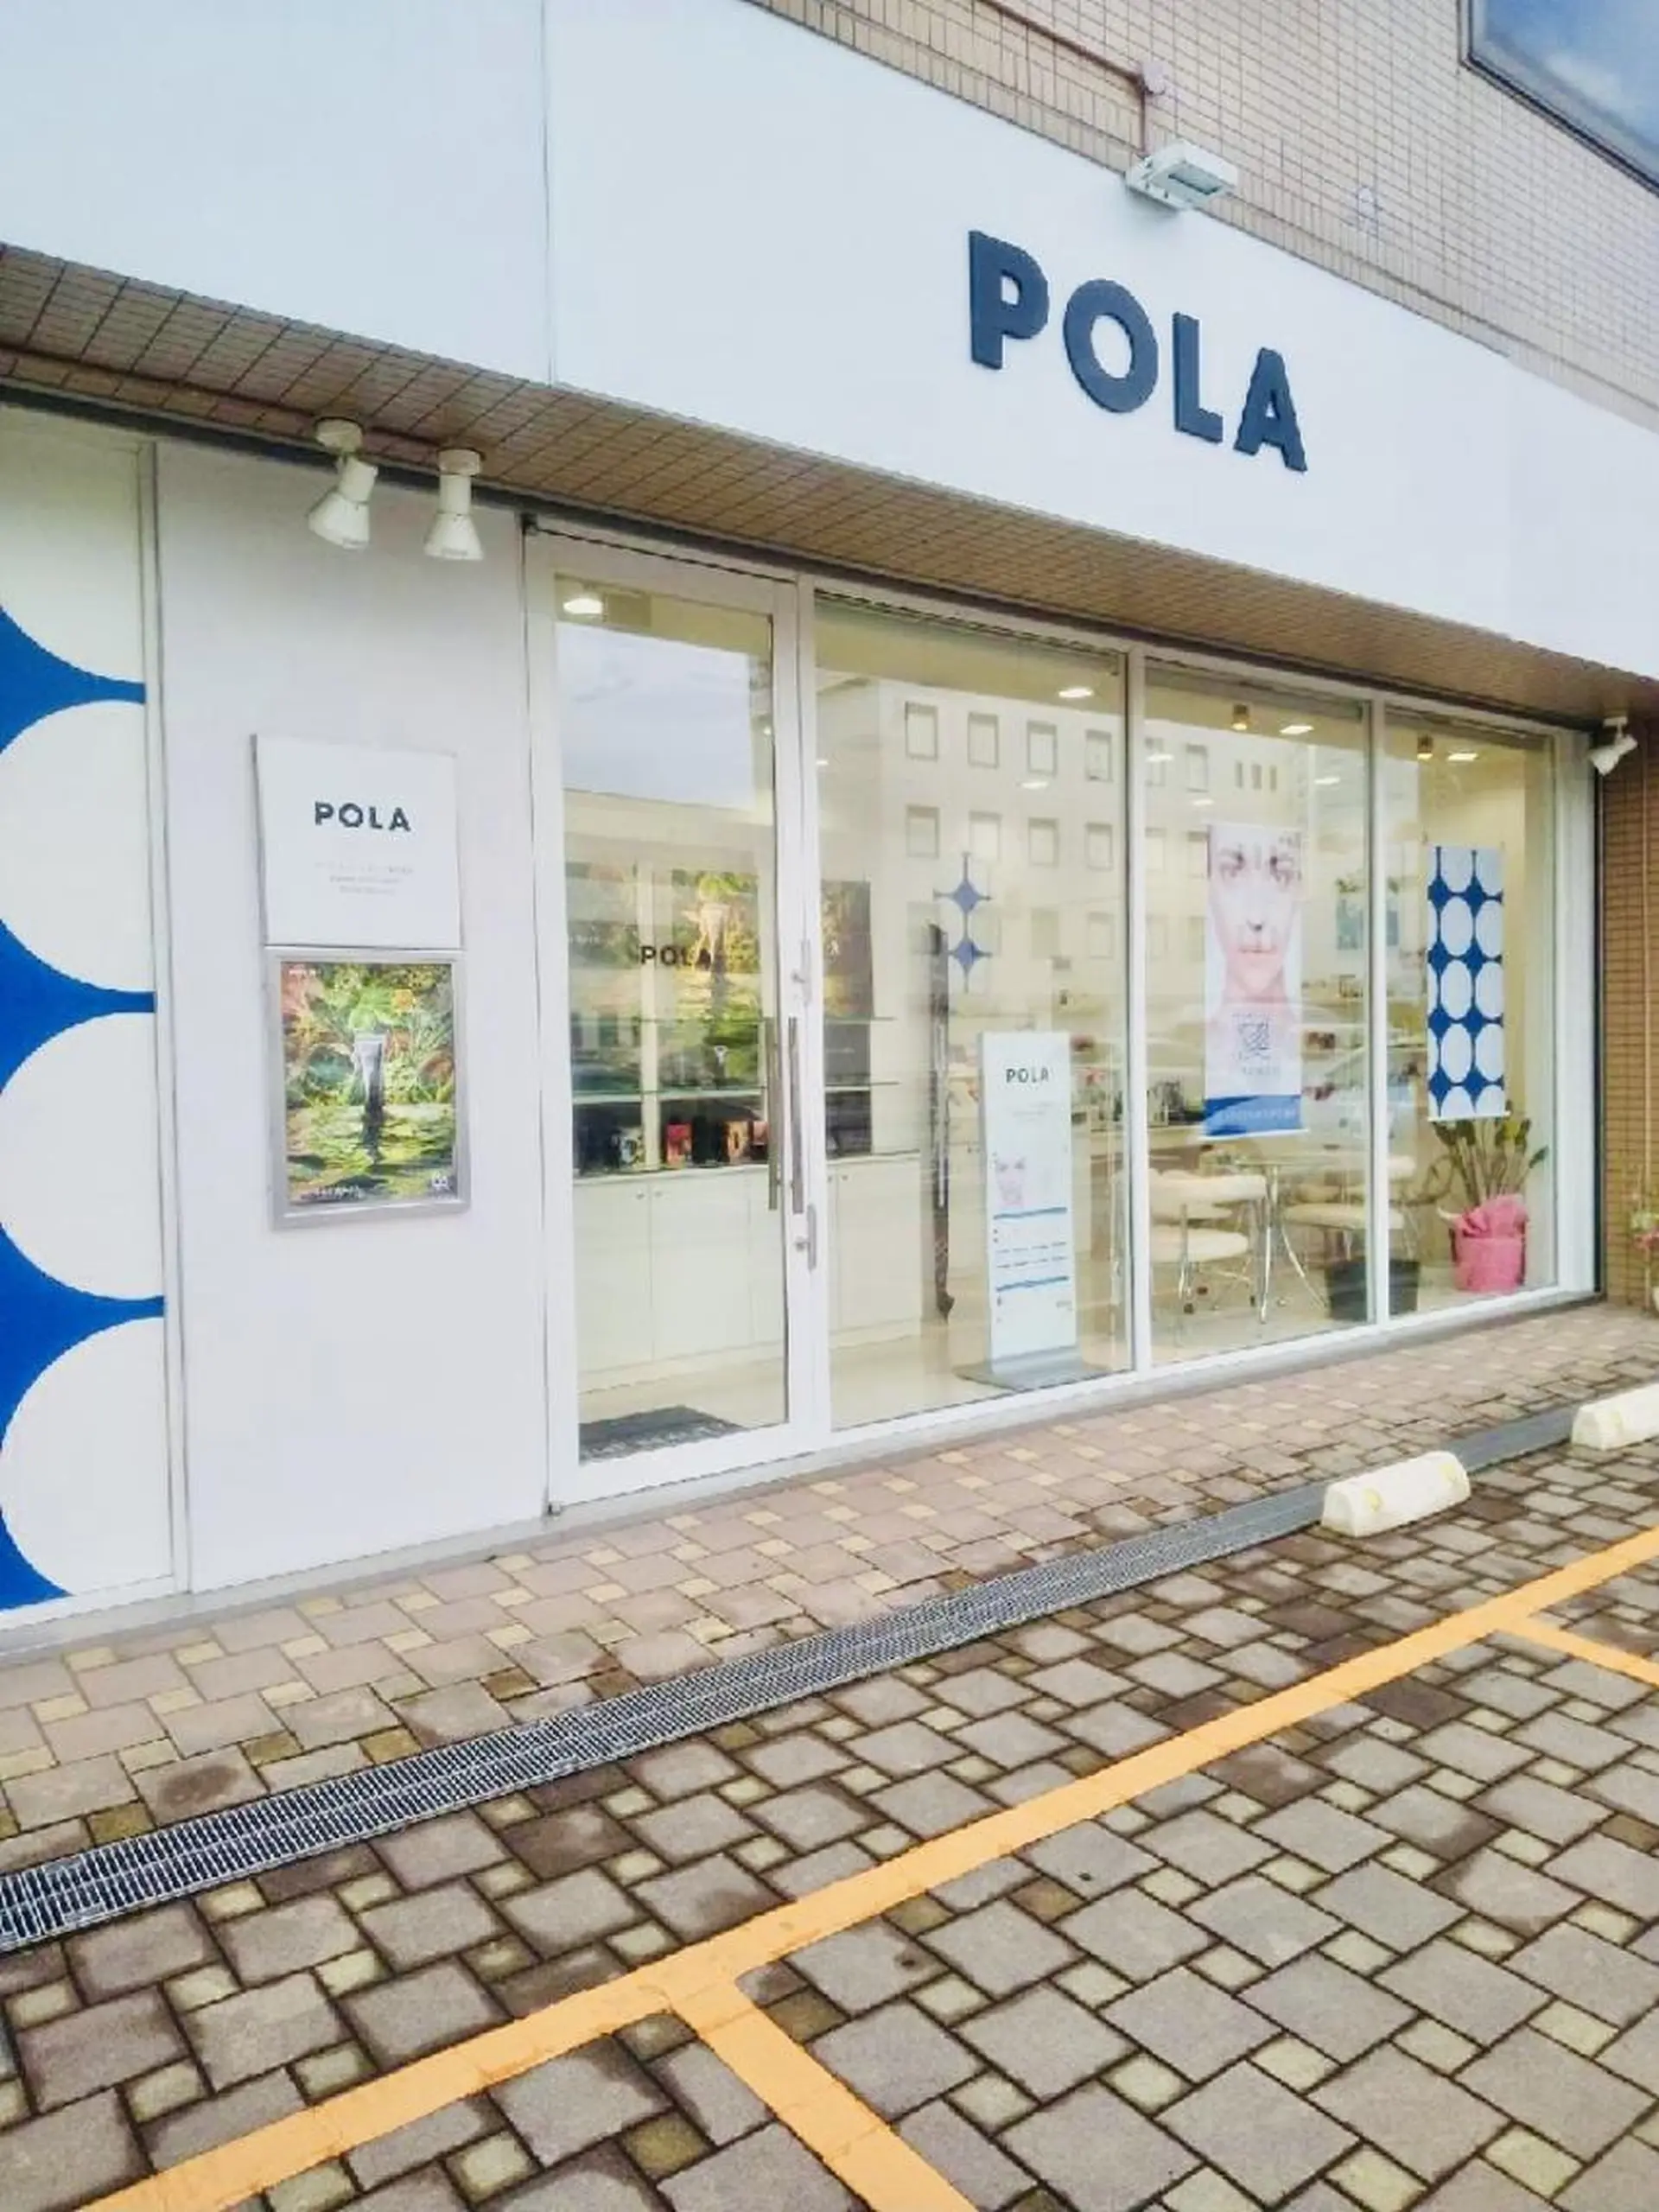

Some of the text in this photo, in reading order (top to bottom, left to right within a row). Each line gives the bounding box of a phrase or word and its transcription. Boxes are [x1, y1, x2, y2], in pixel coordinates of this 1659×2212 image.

[968, 229, 1308, 473] POLA
[314, 801, 411, 832] POLA
[639, 945, 713, 969] POLA
[1006, 1066, 1050, 1084] POLA
